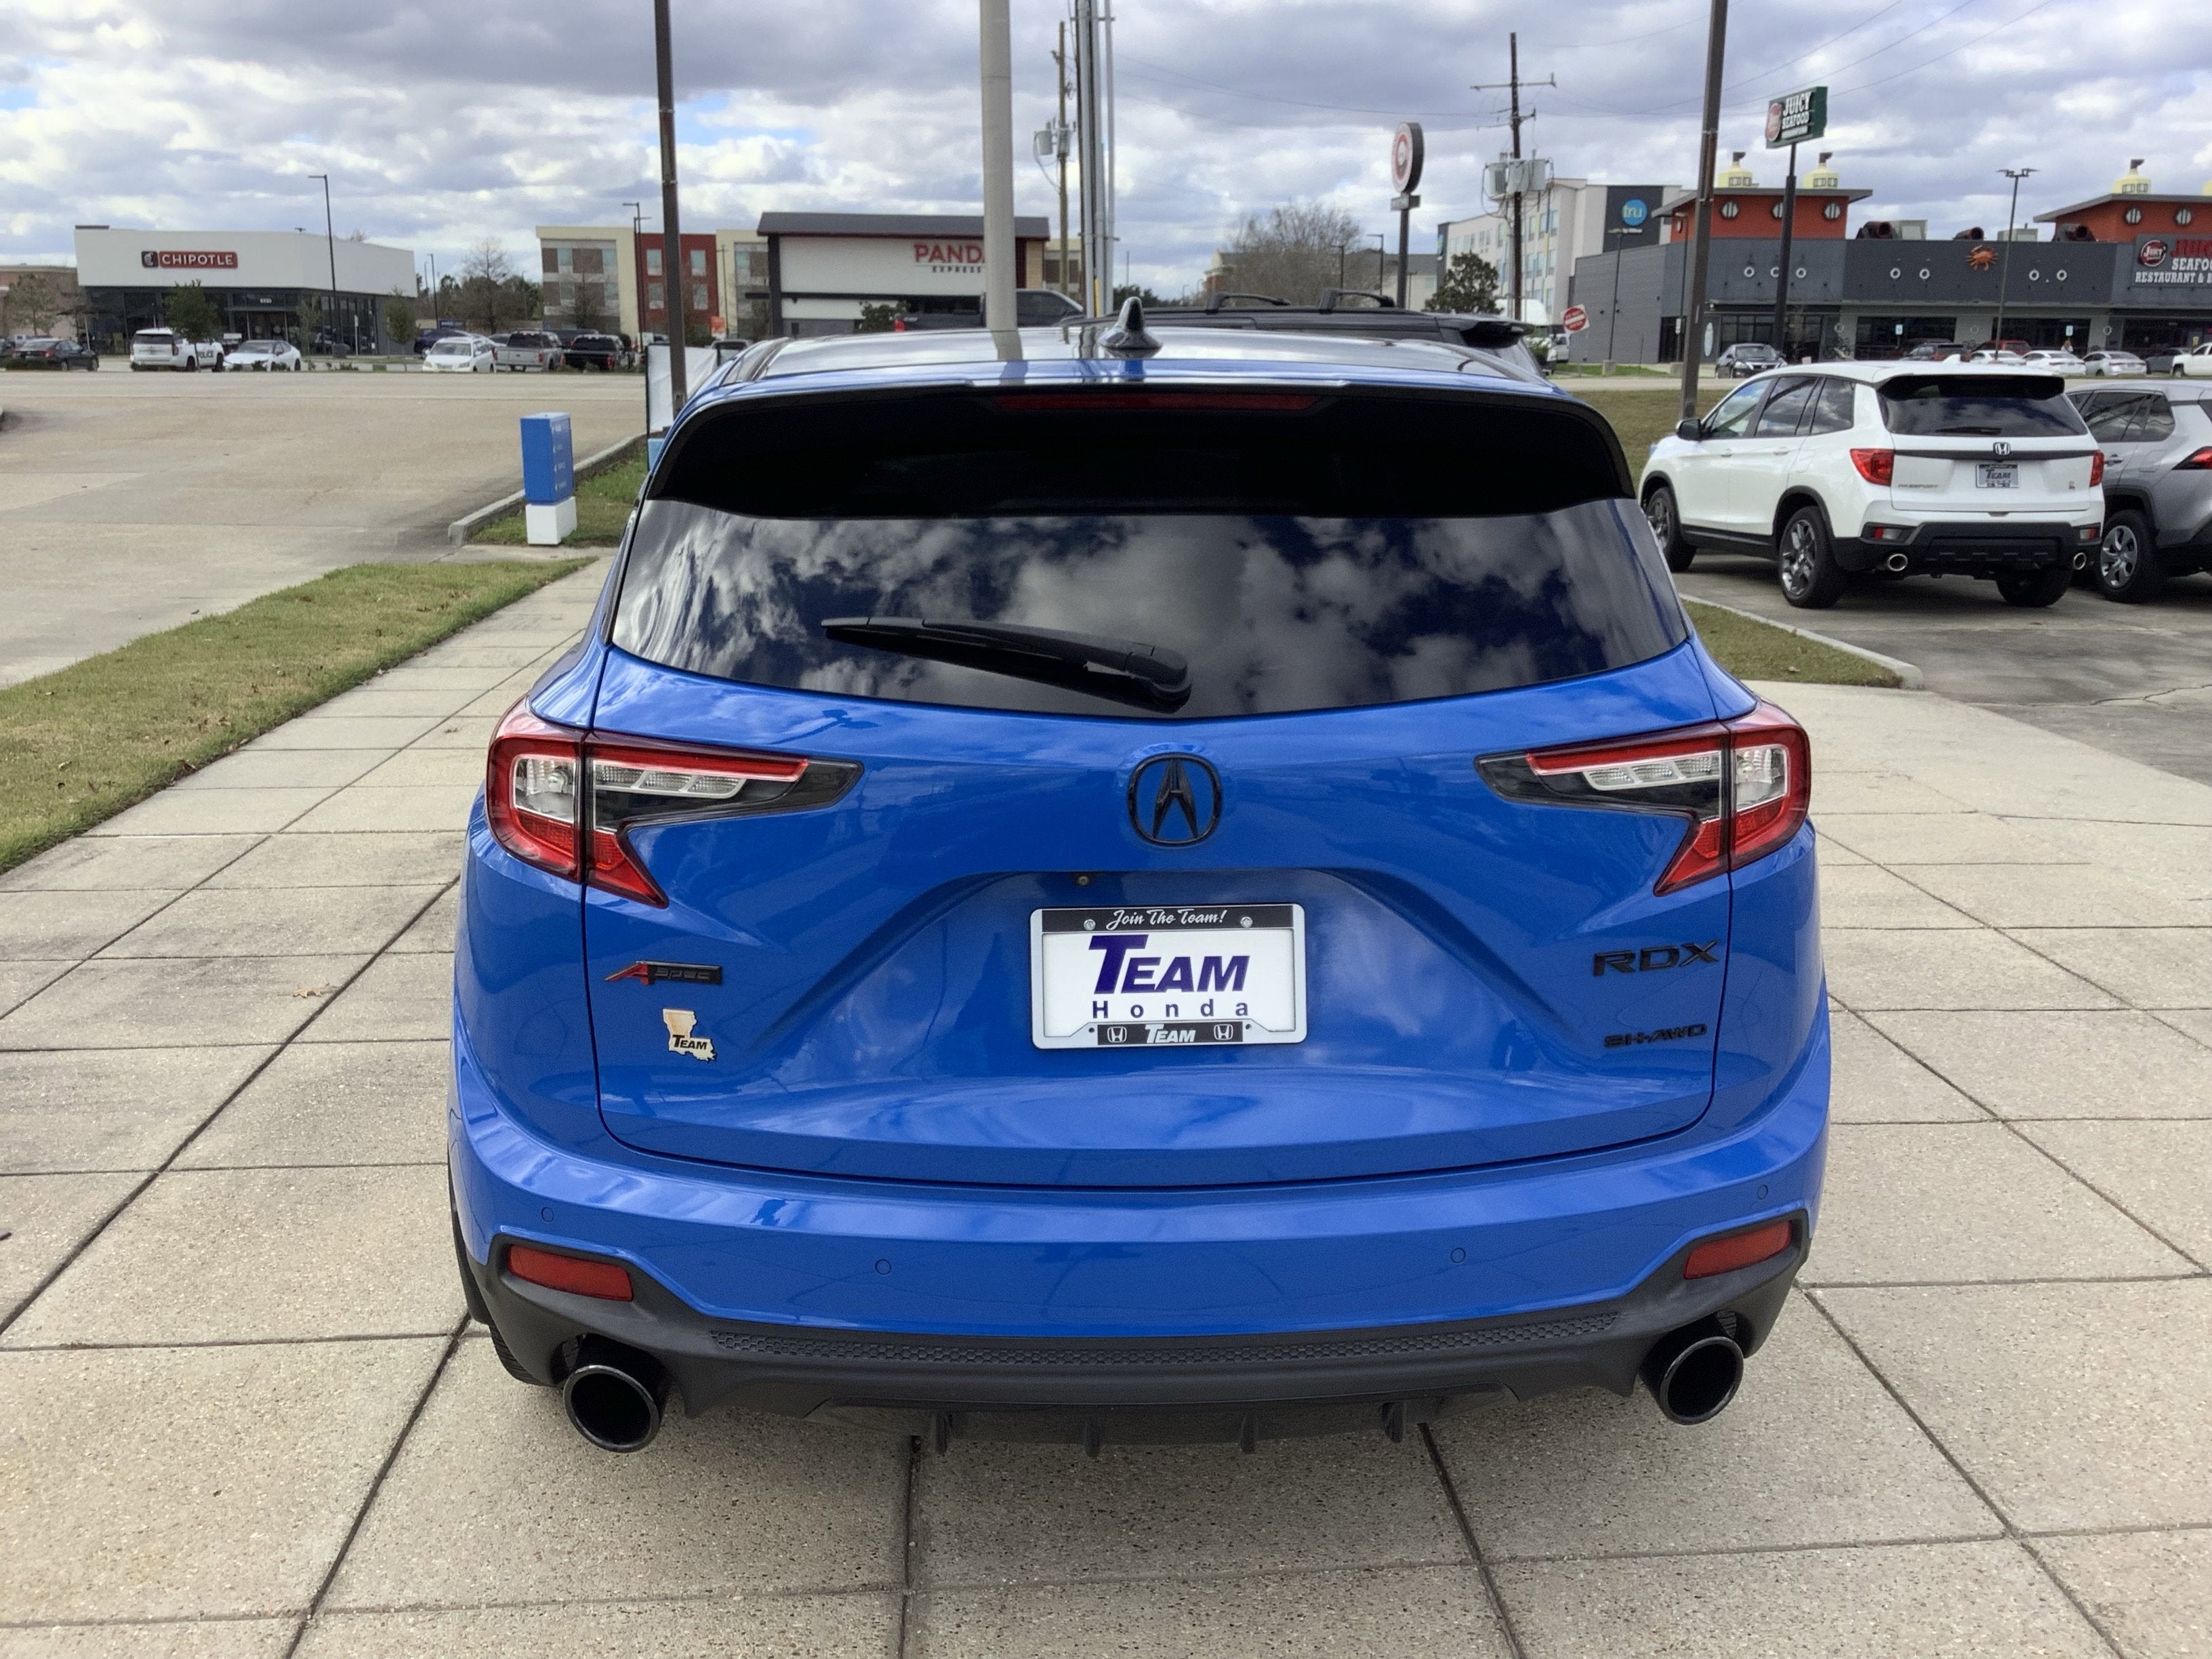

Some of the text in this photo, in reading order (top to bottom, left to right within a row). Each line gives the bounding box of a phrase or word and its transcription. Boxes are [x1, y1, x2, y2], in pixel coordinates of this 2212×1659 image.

[1782, 91, 1812, 117] JUICY
[1782, 110, 1809, 129] SEAFOOD
[162, 254, 233, 265] CHIPOTLE
[914, 244, 985, 263] PAND
[2135, 272, 2196, 283] RESTAURANT
[2198, 272, 2205, 283] &
[1986, 469, 2011, 478] TEAM
[1106, 908, 1227, 930] Join The Team!
[1088, 935, 1250, 994] TEAM
[1593, 939, 1720, 977] RDX
[1092, 998, 1248, 1019] Honda
[672, 1035, 708, 1050] TEAM
[1145, 1024, 1195, 1044] TEAM
[1604, 1024, 1707, 1047] SH-AWD
